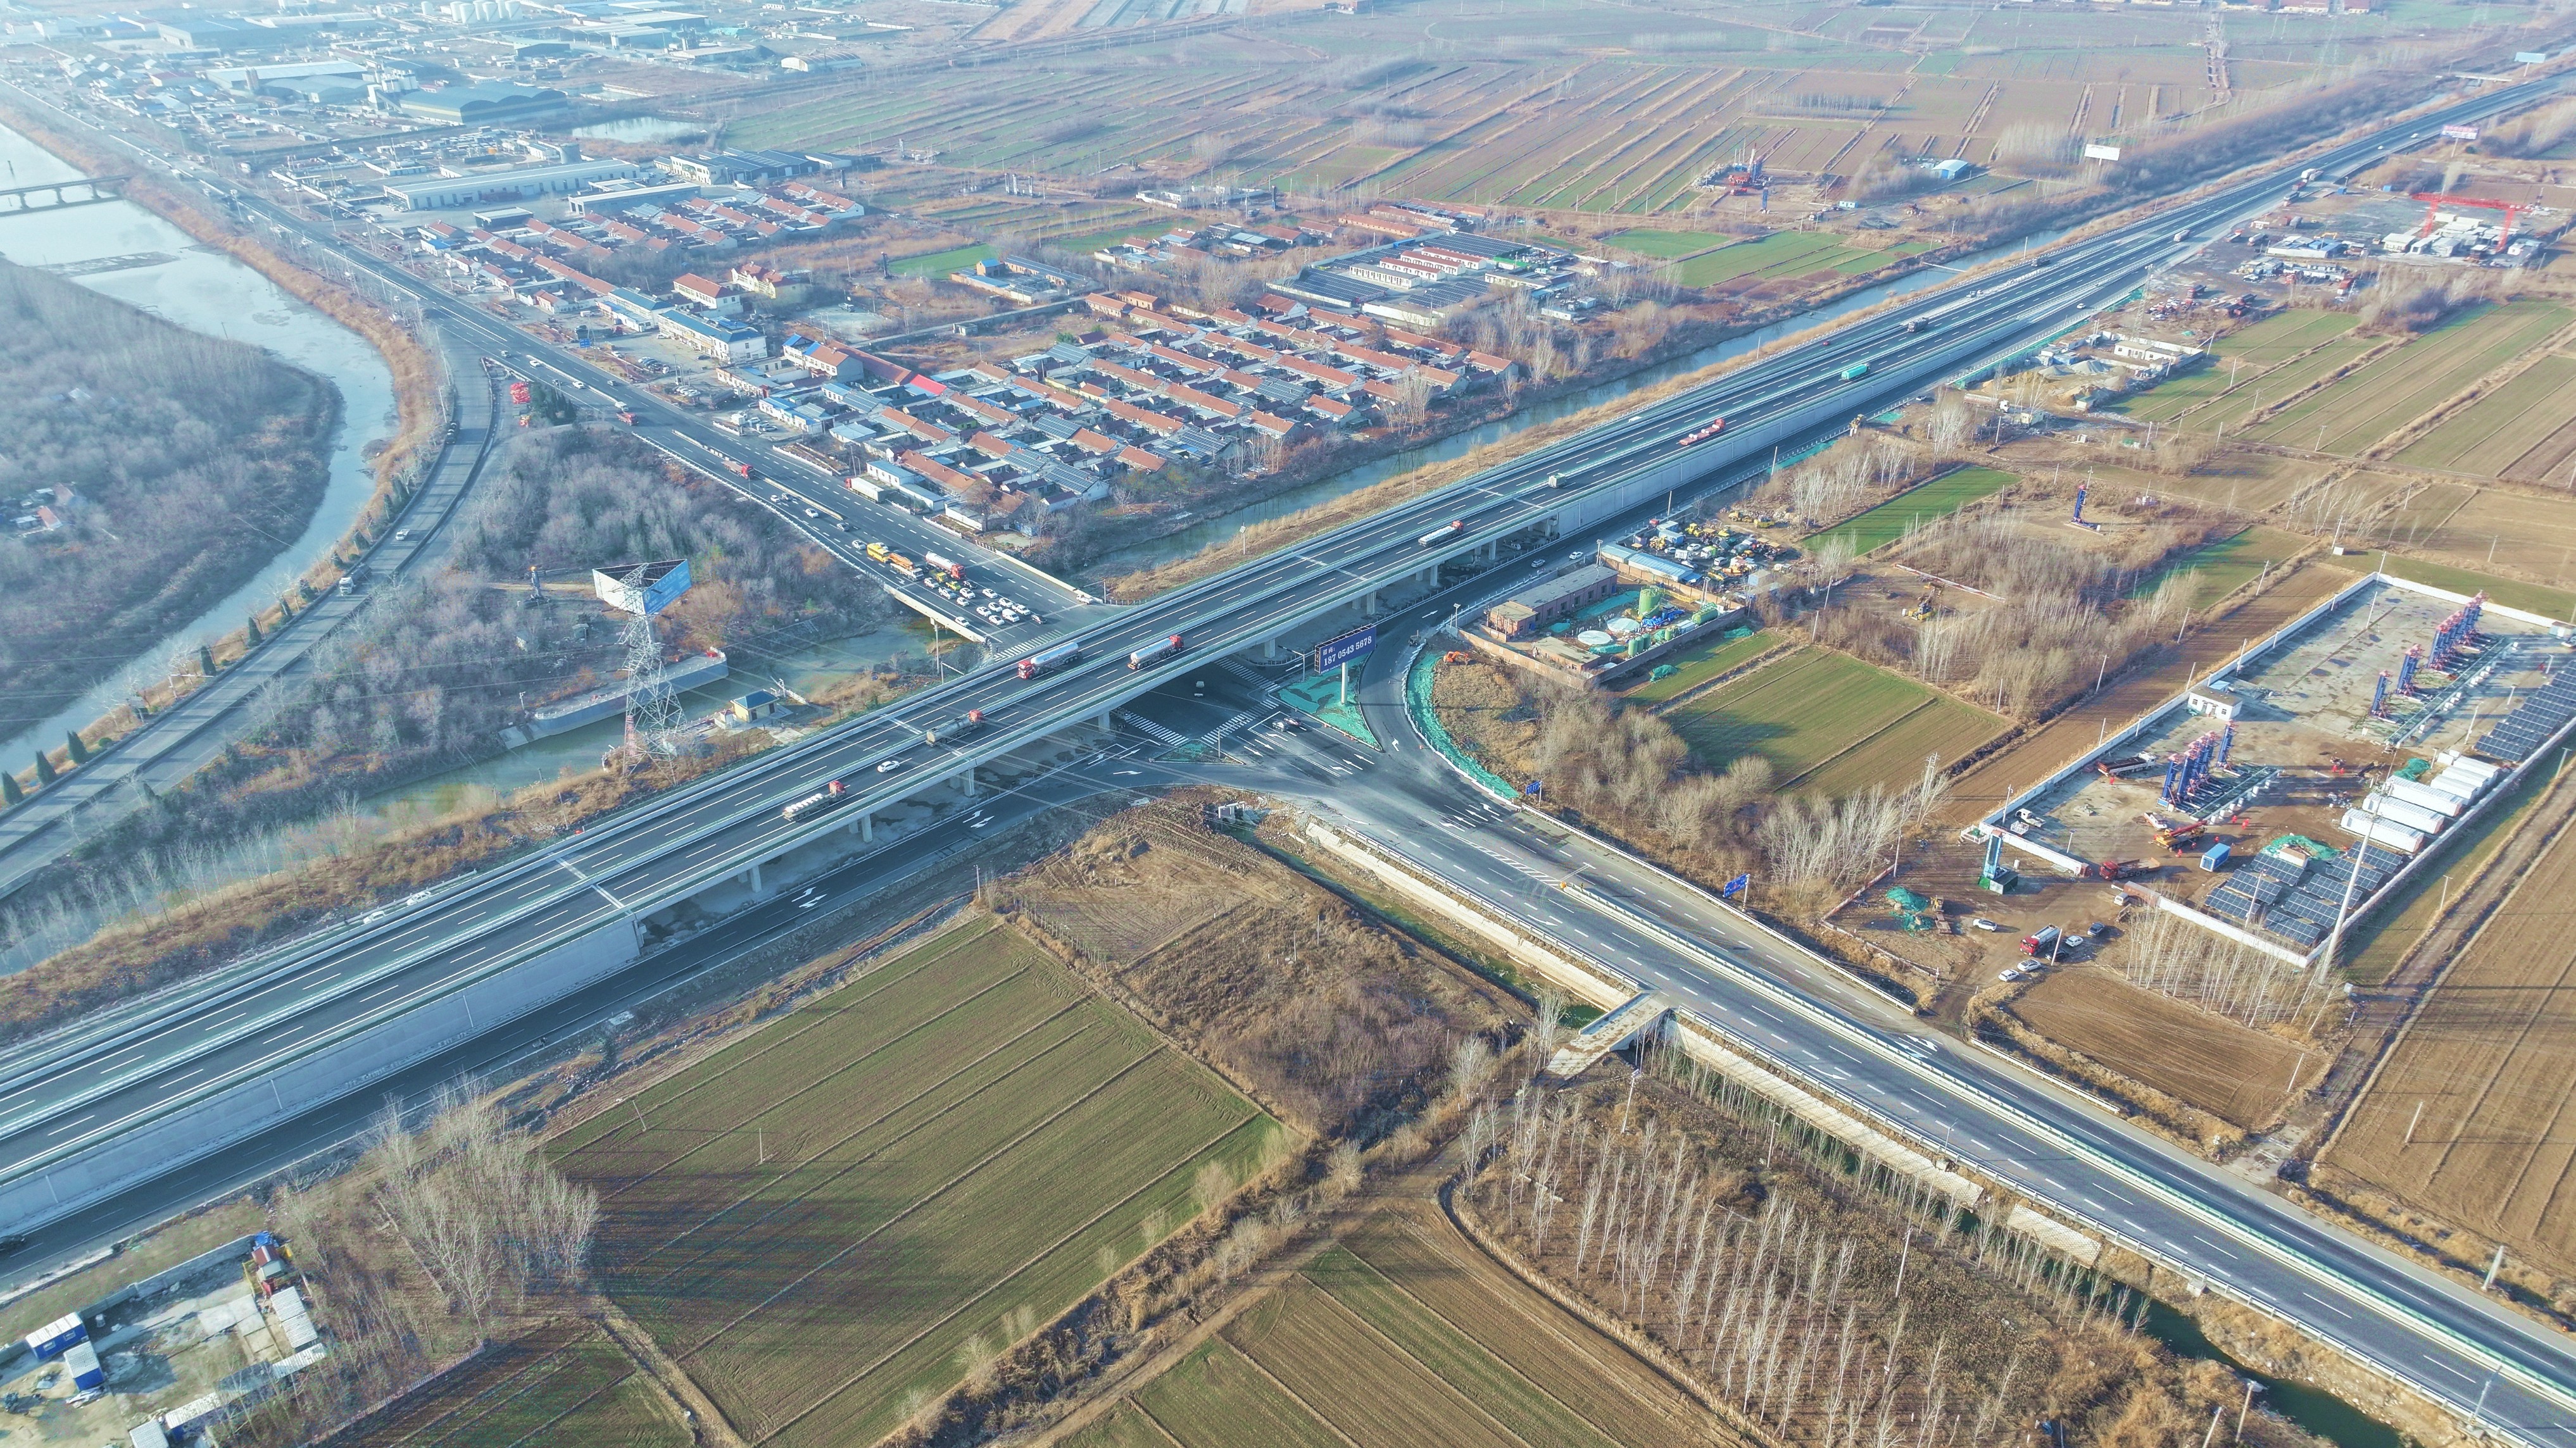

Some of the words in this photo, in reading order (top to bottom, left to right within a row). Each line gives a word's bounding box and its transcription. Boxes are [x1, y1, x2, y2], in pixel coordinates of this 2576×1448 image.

[1324, 654, 1336, 666] 187
[1338, 644, 1354, 659] 0543
[1355, 635, 1372, 650] 5678
